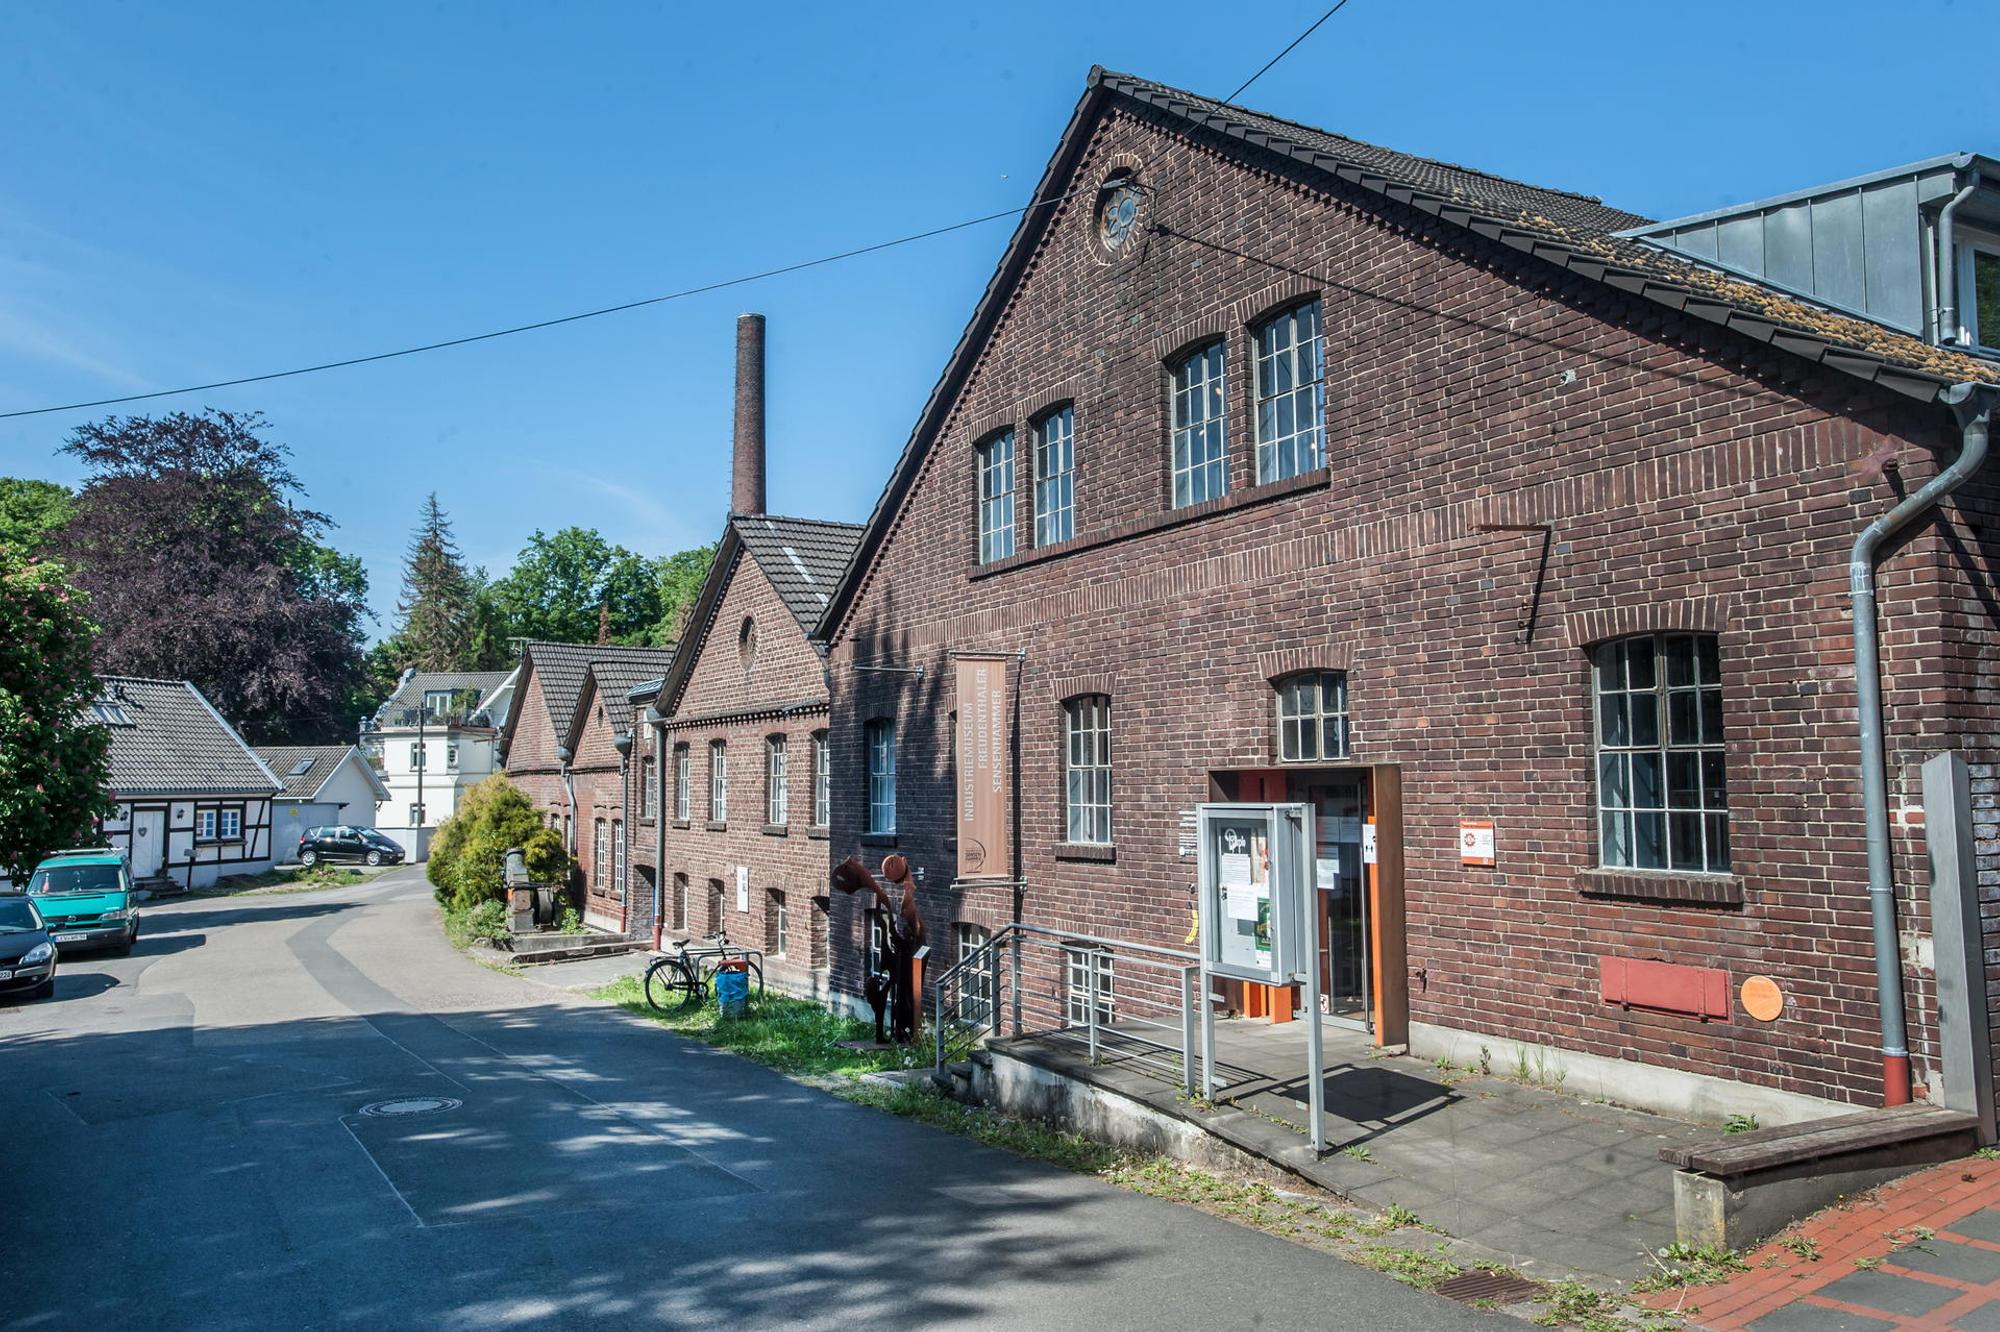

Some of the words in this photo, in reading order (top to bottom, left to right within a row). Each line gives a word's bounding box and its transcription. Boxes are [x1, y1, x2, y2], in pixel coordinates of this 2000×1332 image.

[963, 703, 974, 822] INDUSTRIEMUSEUM
[976, 667, 988, 769] FREUDENTHALER
[992, 688, 1002, 793] SENSENHAMMER
